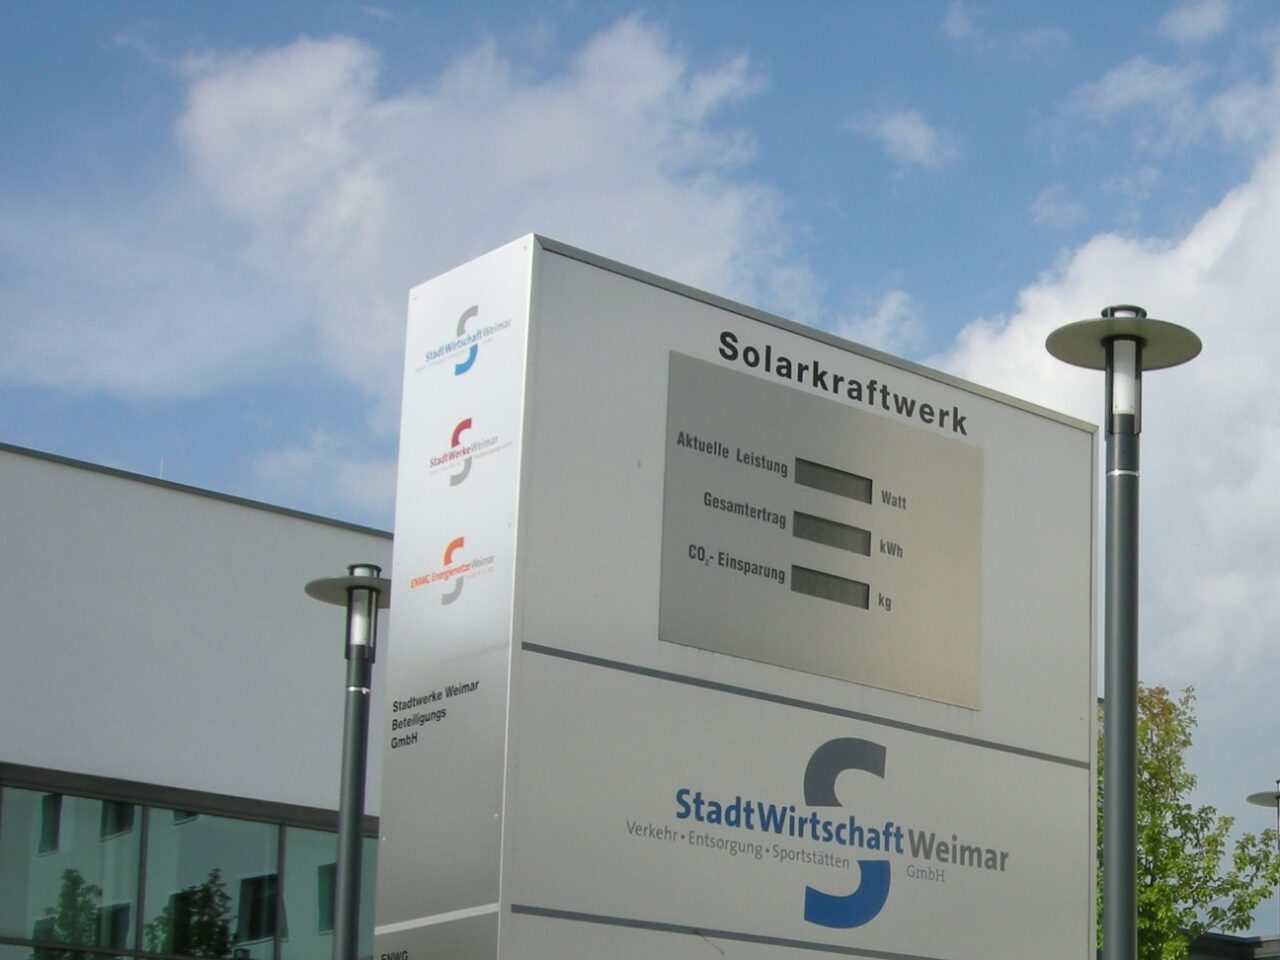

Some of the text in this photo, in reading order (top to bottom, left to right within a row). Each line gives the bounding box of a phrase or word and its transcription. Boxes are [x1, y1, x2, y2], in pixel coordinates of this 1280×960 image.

[718, 331, 968, 436] Solarkraftwerk
[677, 431, 788, 478] Aktuelle Leistung
[703, 491, 786, 529] Gesamtertrag
[881, 490, 907, 511] Watt
[880, 540, 903, 559] kWh
[878, 592, 892, 612] kg
[392, 680, 480, 713] Stadtwerke Weimar
[391, 708, 447, 731] Beteiligungs
[390, 731, 418, 749] GmbH
[626, 820, 850, 869] Verkehr Entsorgung Sportstätten
[906, 864, 946, 883] GmbH
